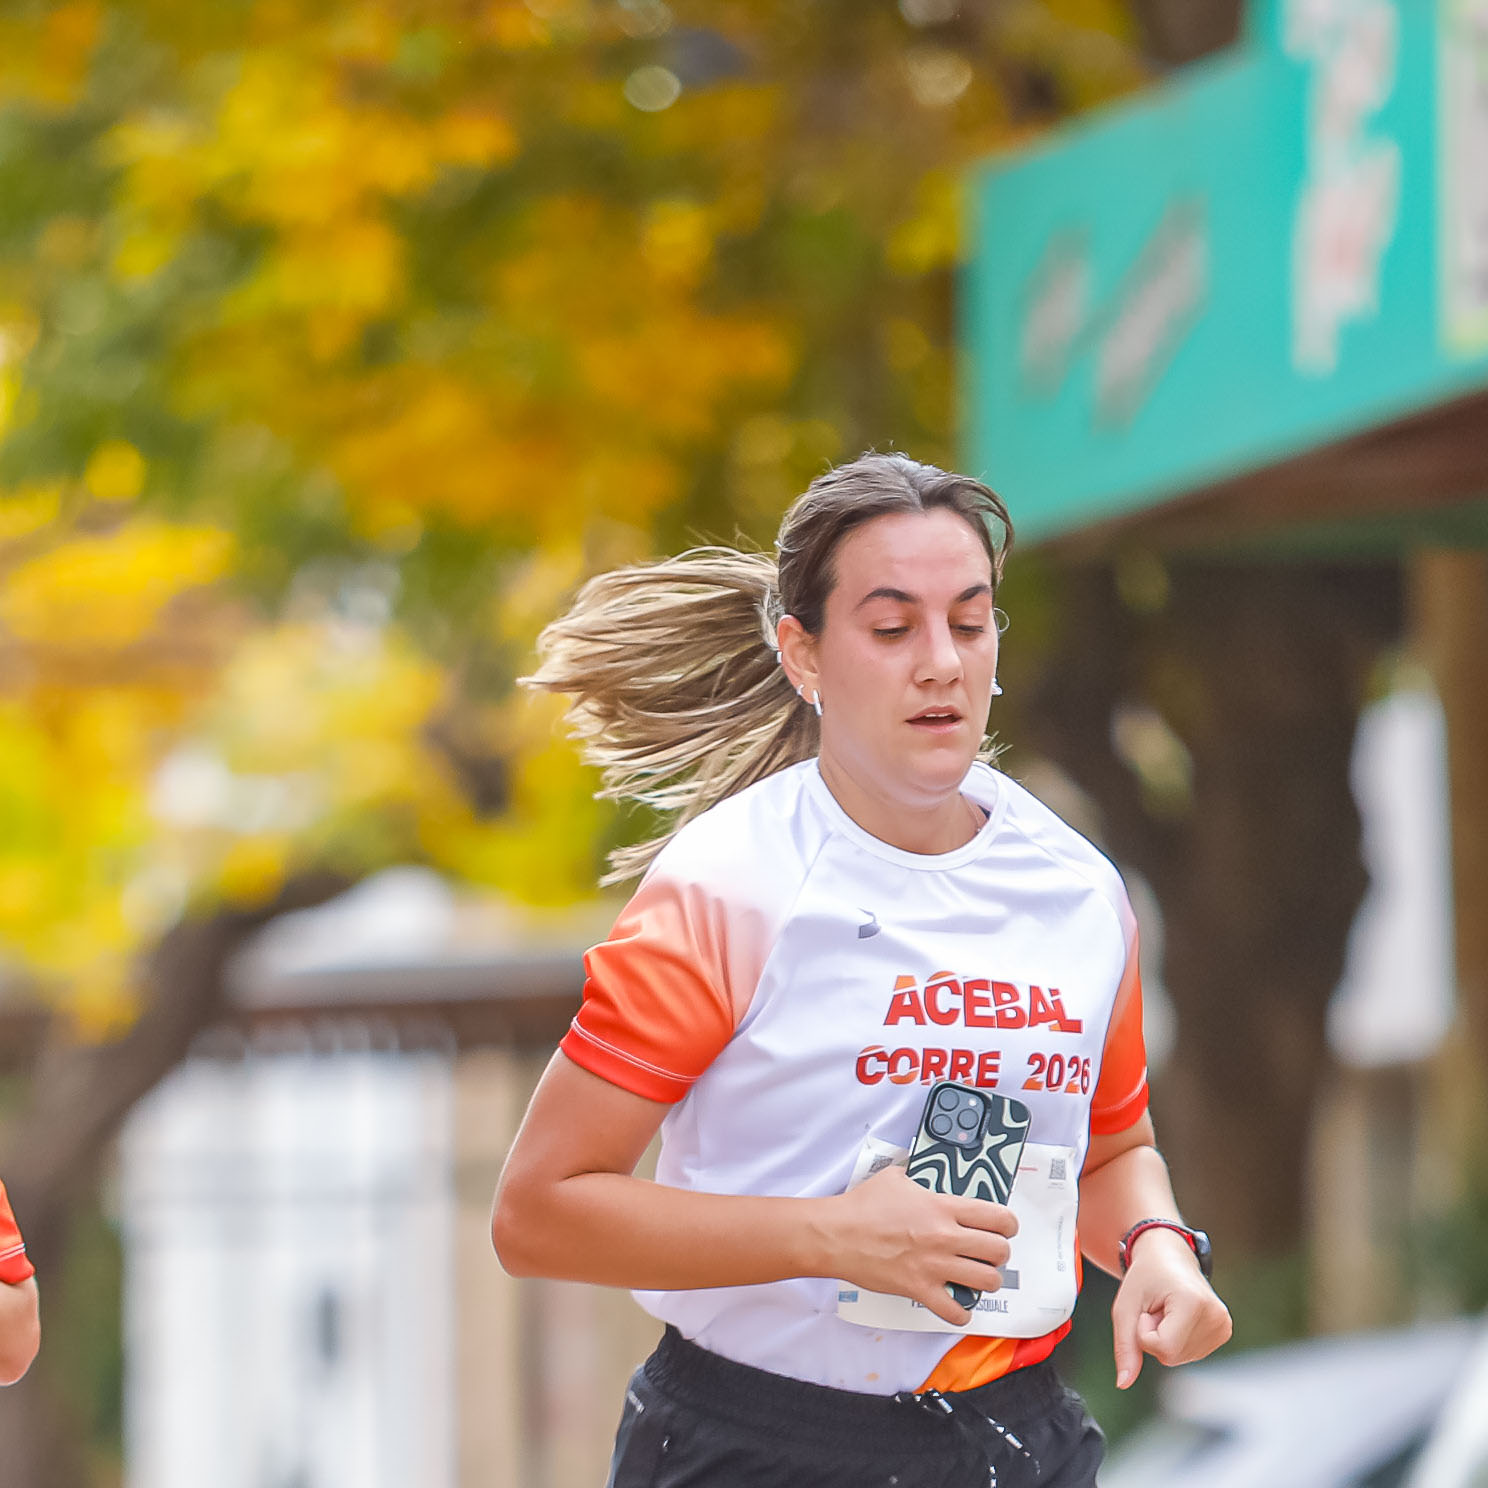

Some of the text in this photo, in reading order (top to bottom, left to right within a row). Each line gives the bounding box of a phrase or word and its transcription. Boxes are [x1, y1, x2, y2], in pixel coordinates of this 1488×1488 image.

[883, 970, 1083, 1033] ACEBAL
[855, 1045, 1091, 1096] CORRE 2026
[976, 1298, 1009, 1313] SQUALE
